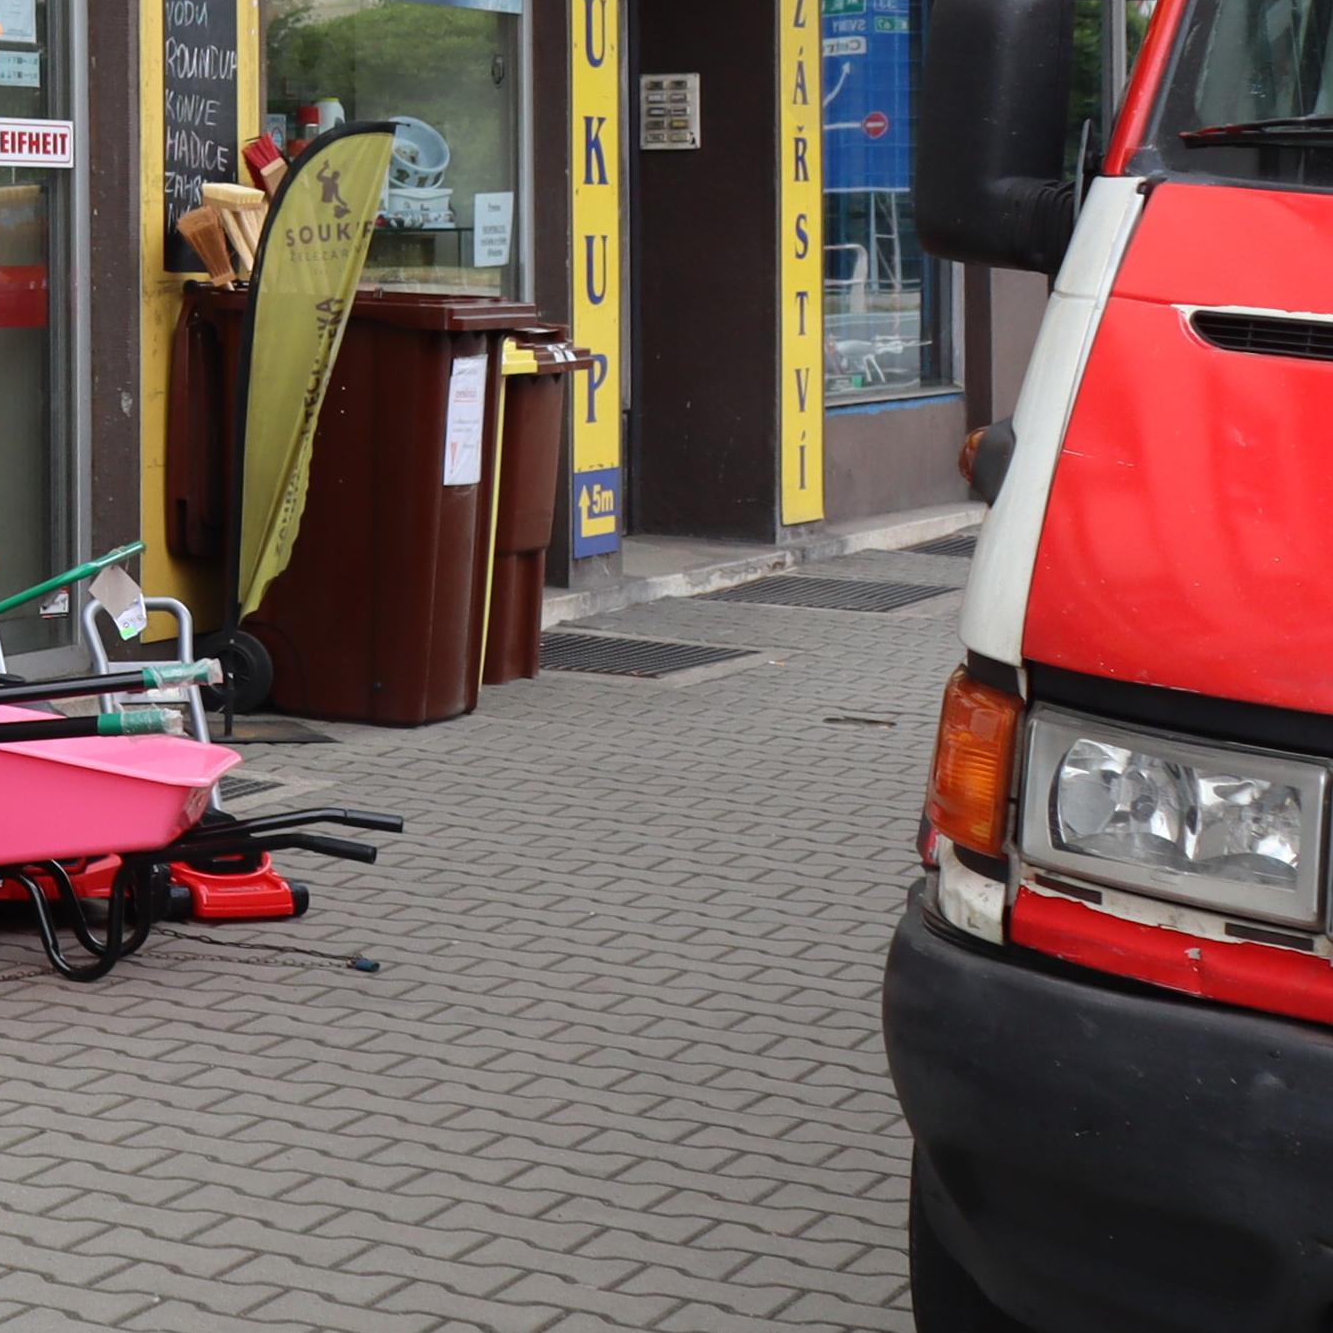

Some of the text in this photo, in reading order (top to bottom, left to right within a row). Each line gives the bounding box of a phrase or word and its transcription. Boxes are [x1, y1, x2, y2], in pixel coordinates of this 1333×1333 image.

[165, 0, 208, 31] VODU
[165, 88, 221, 126] KONVE
[165, 126, 229, 172] HADICE
[165, 171, 205, 205] ZAHR
[286, 220, 373, 247] SOUKP
[592, 484, 614, 514] 5m
